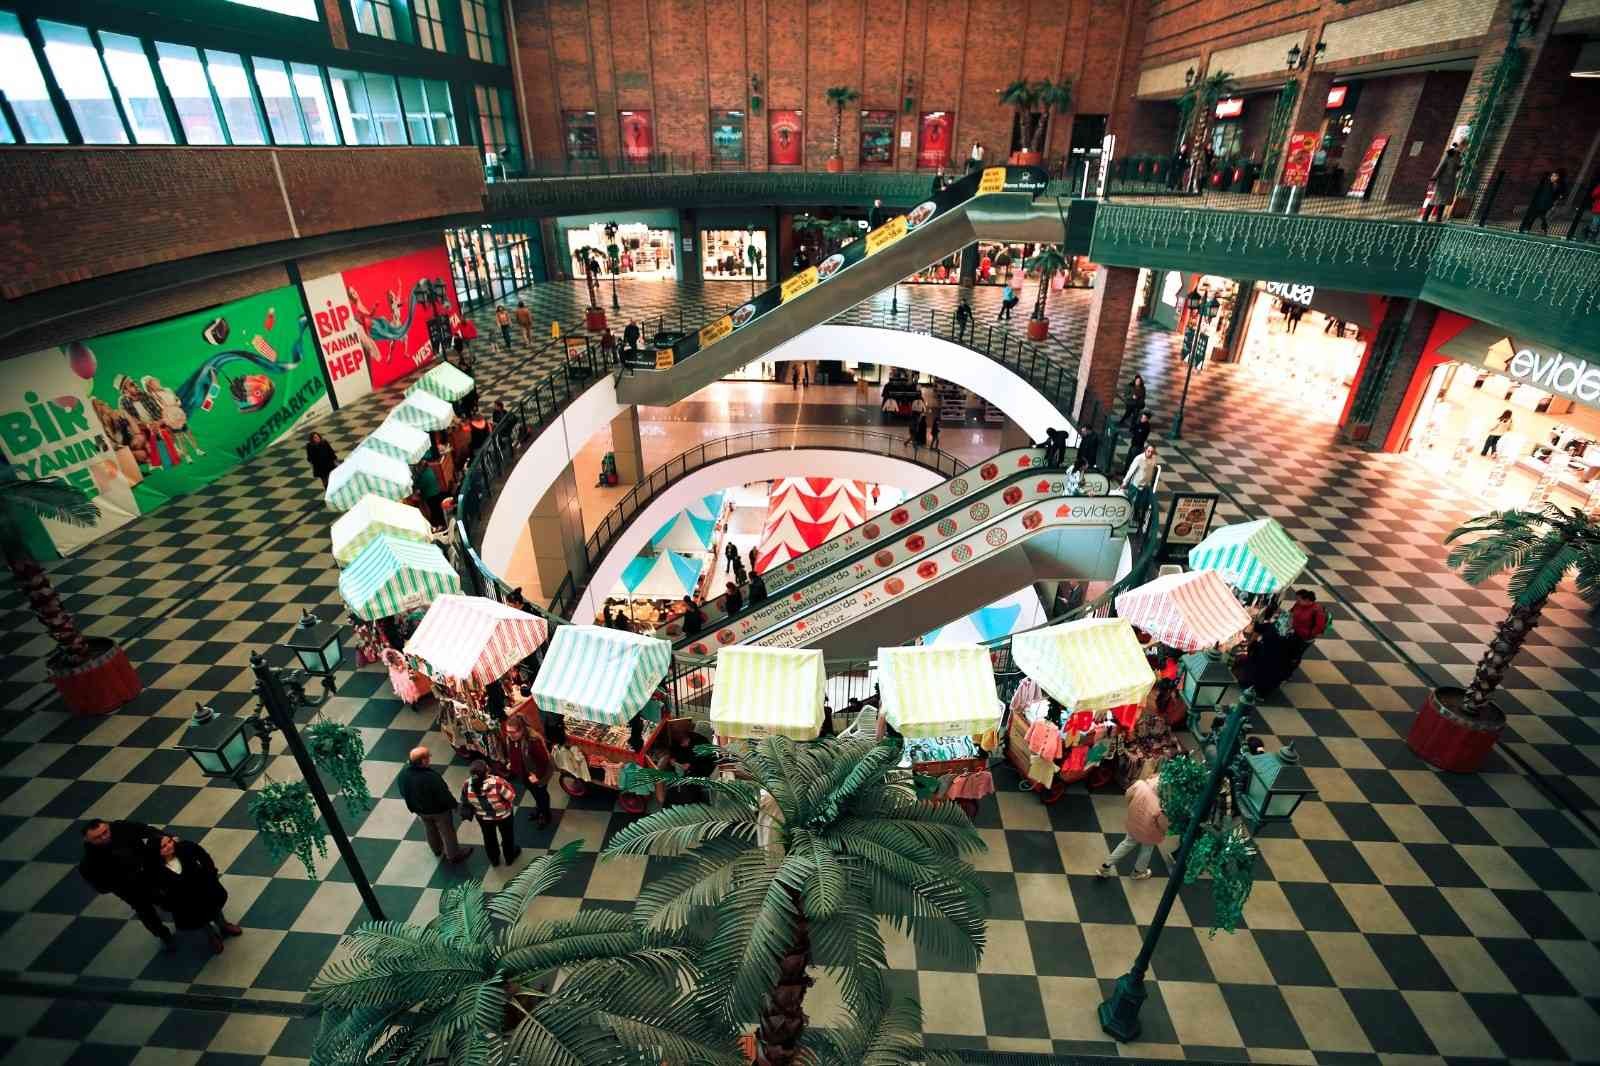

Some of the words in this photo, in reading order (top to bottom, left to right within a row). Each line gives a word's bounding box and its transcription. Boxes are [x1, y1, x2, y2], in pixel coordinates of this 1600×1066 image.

[322, 332, 360, 356] YANIM
[328, 349, 363, 382] HEP
[1510, 349, 1600, 402] evide
[0, 391, 90, 457] BİR
[235, 376, 323, 459] WESTPARK'TA
[1071, 504, 1127, 518] evidea
[752, 599, 789, 621] Hepimiz
